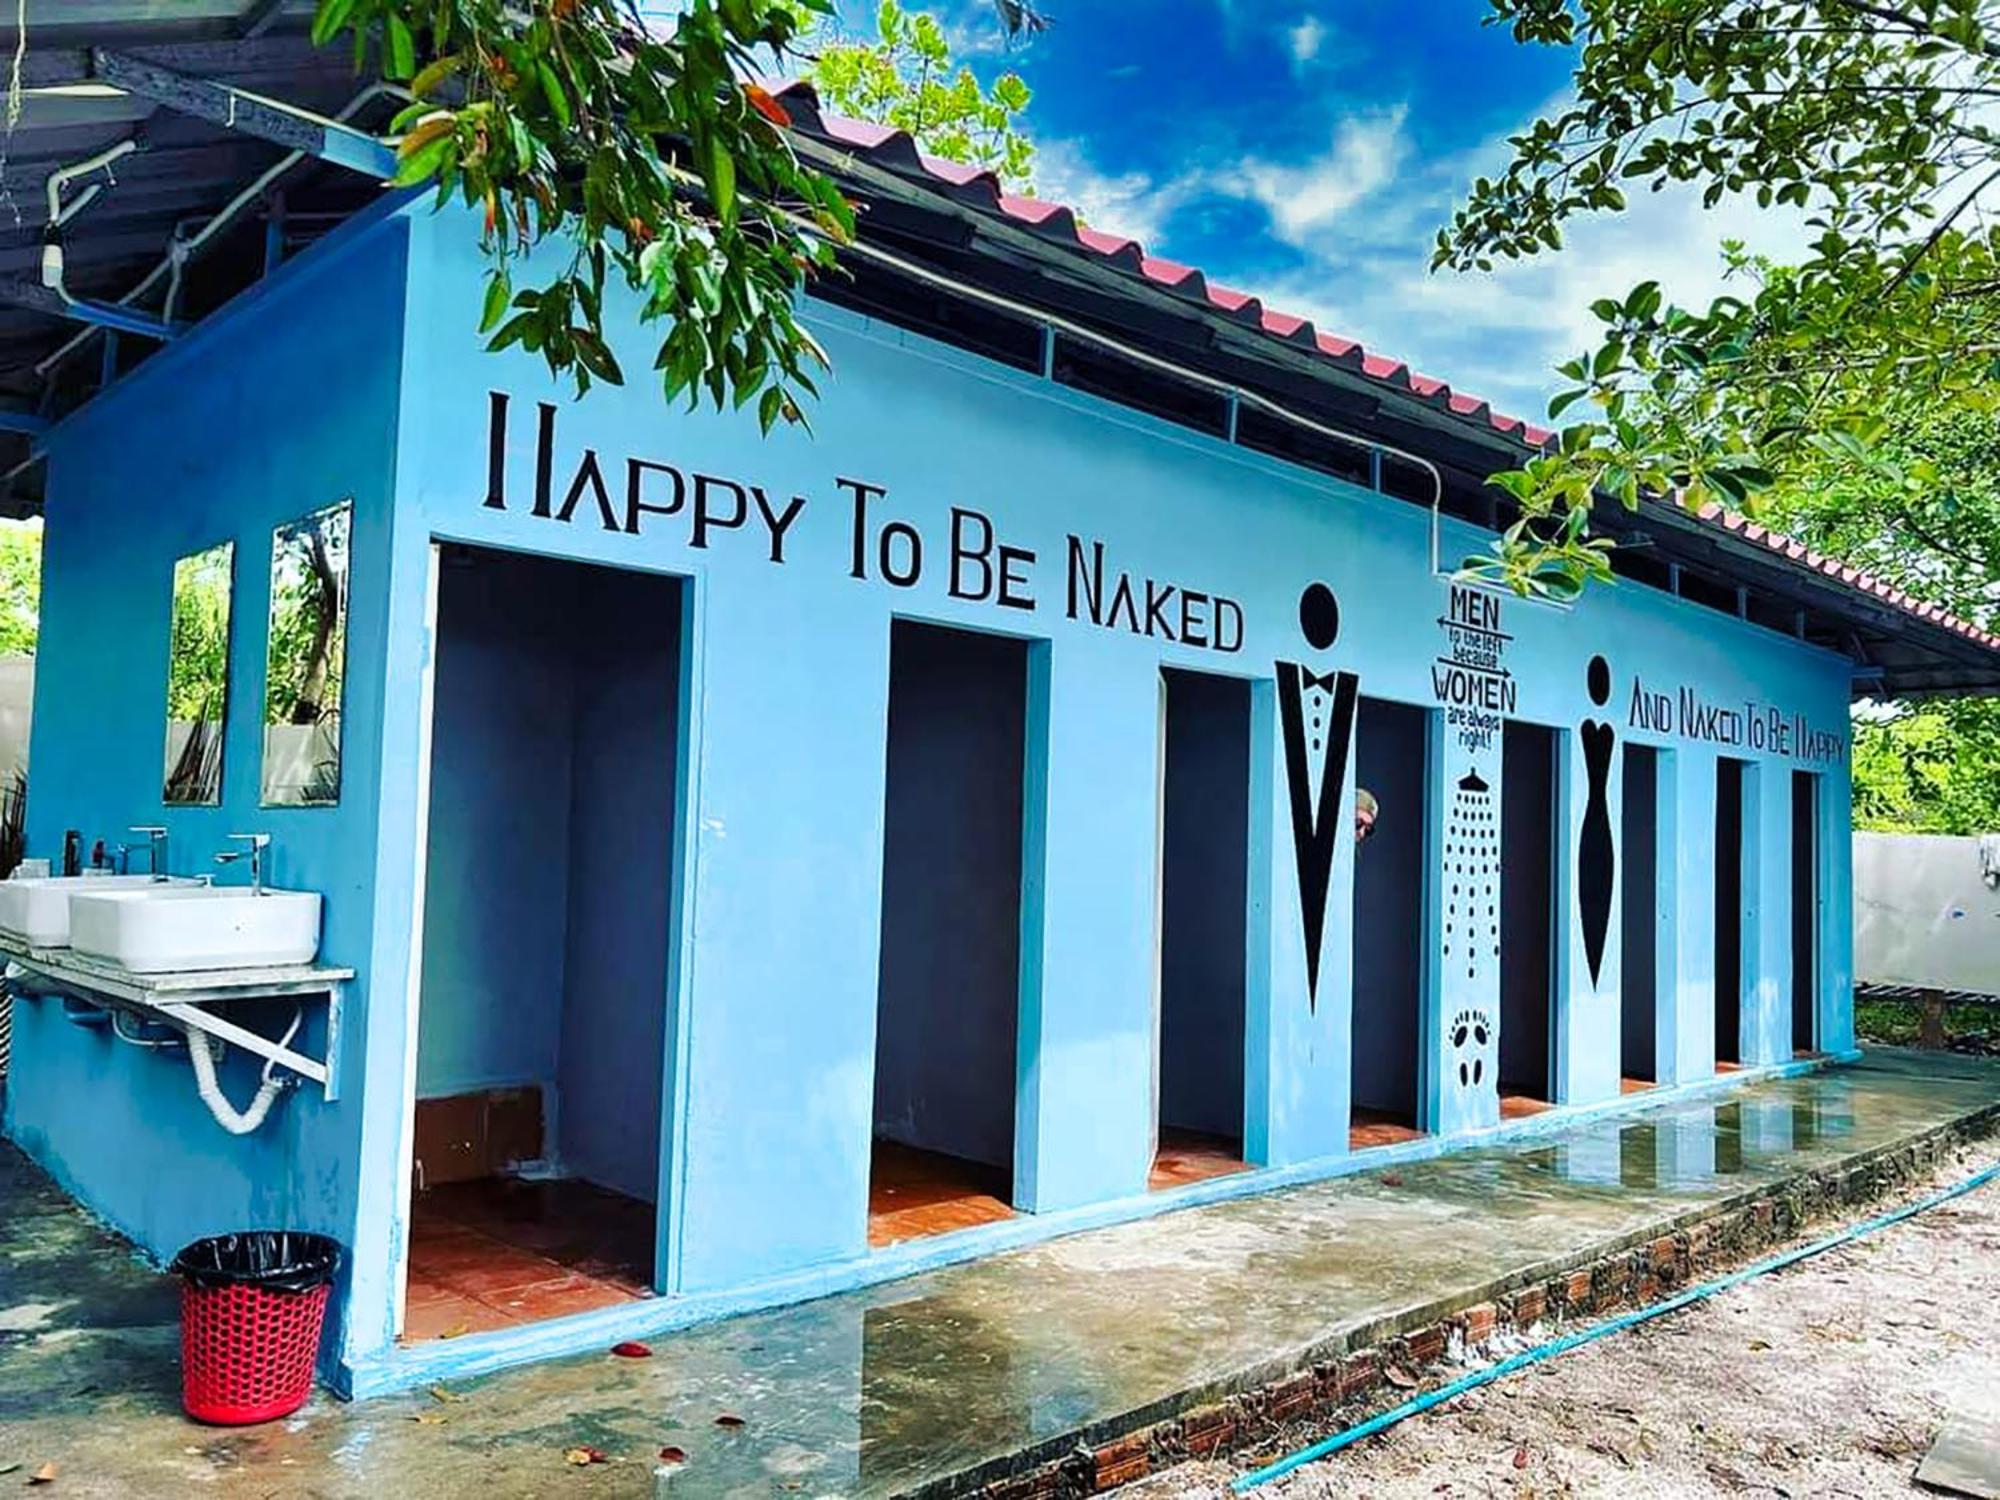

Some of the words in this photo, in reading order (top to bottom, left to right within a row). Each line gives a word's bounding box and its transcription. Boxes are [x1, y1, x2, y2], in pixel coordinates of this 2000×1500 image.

[948, 507, 1036, 610] BE
[1066, 534, 1244, 652] NAKED
[1451, 586, 1499, 630] MEN
[1453, 643, 1498, 669] because
[1464, 631, 1481, 648] the
[1483, 634, 1504, 655] left
[1432, 666, 1516, 713] WOMEN
[1448, 706, 1466, 726] are
[1629, 675, 1671, 733] AND
[1680, 686, 1743, 745] NAKED
[1767, 707, 1790, 755] BE
[1458, 728, 1491, 754] right!
